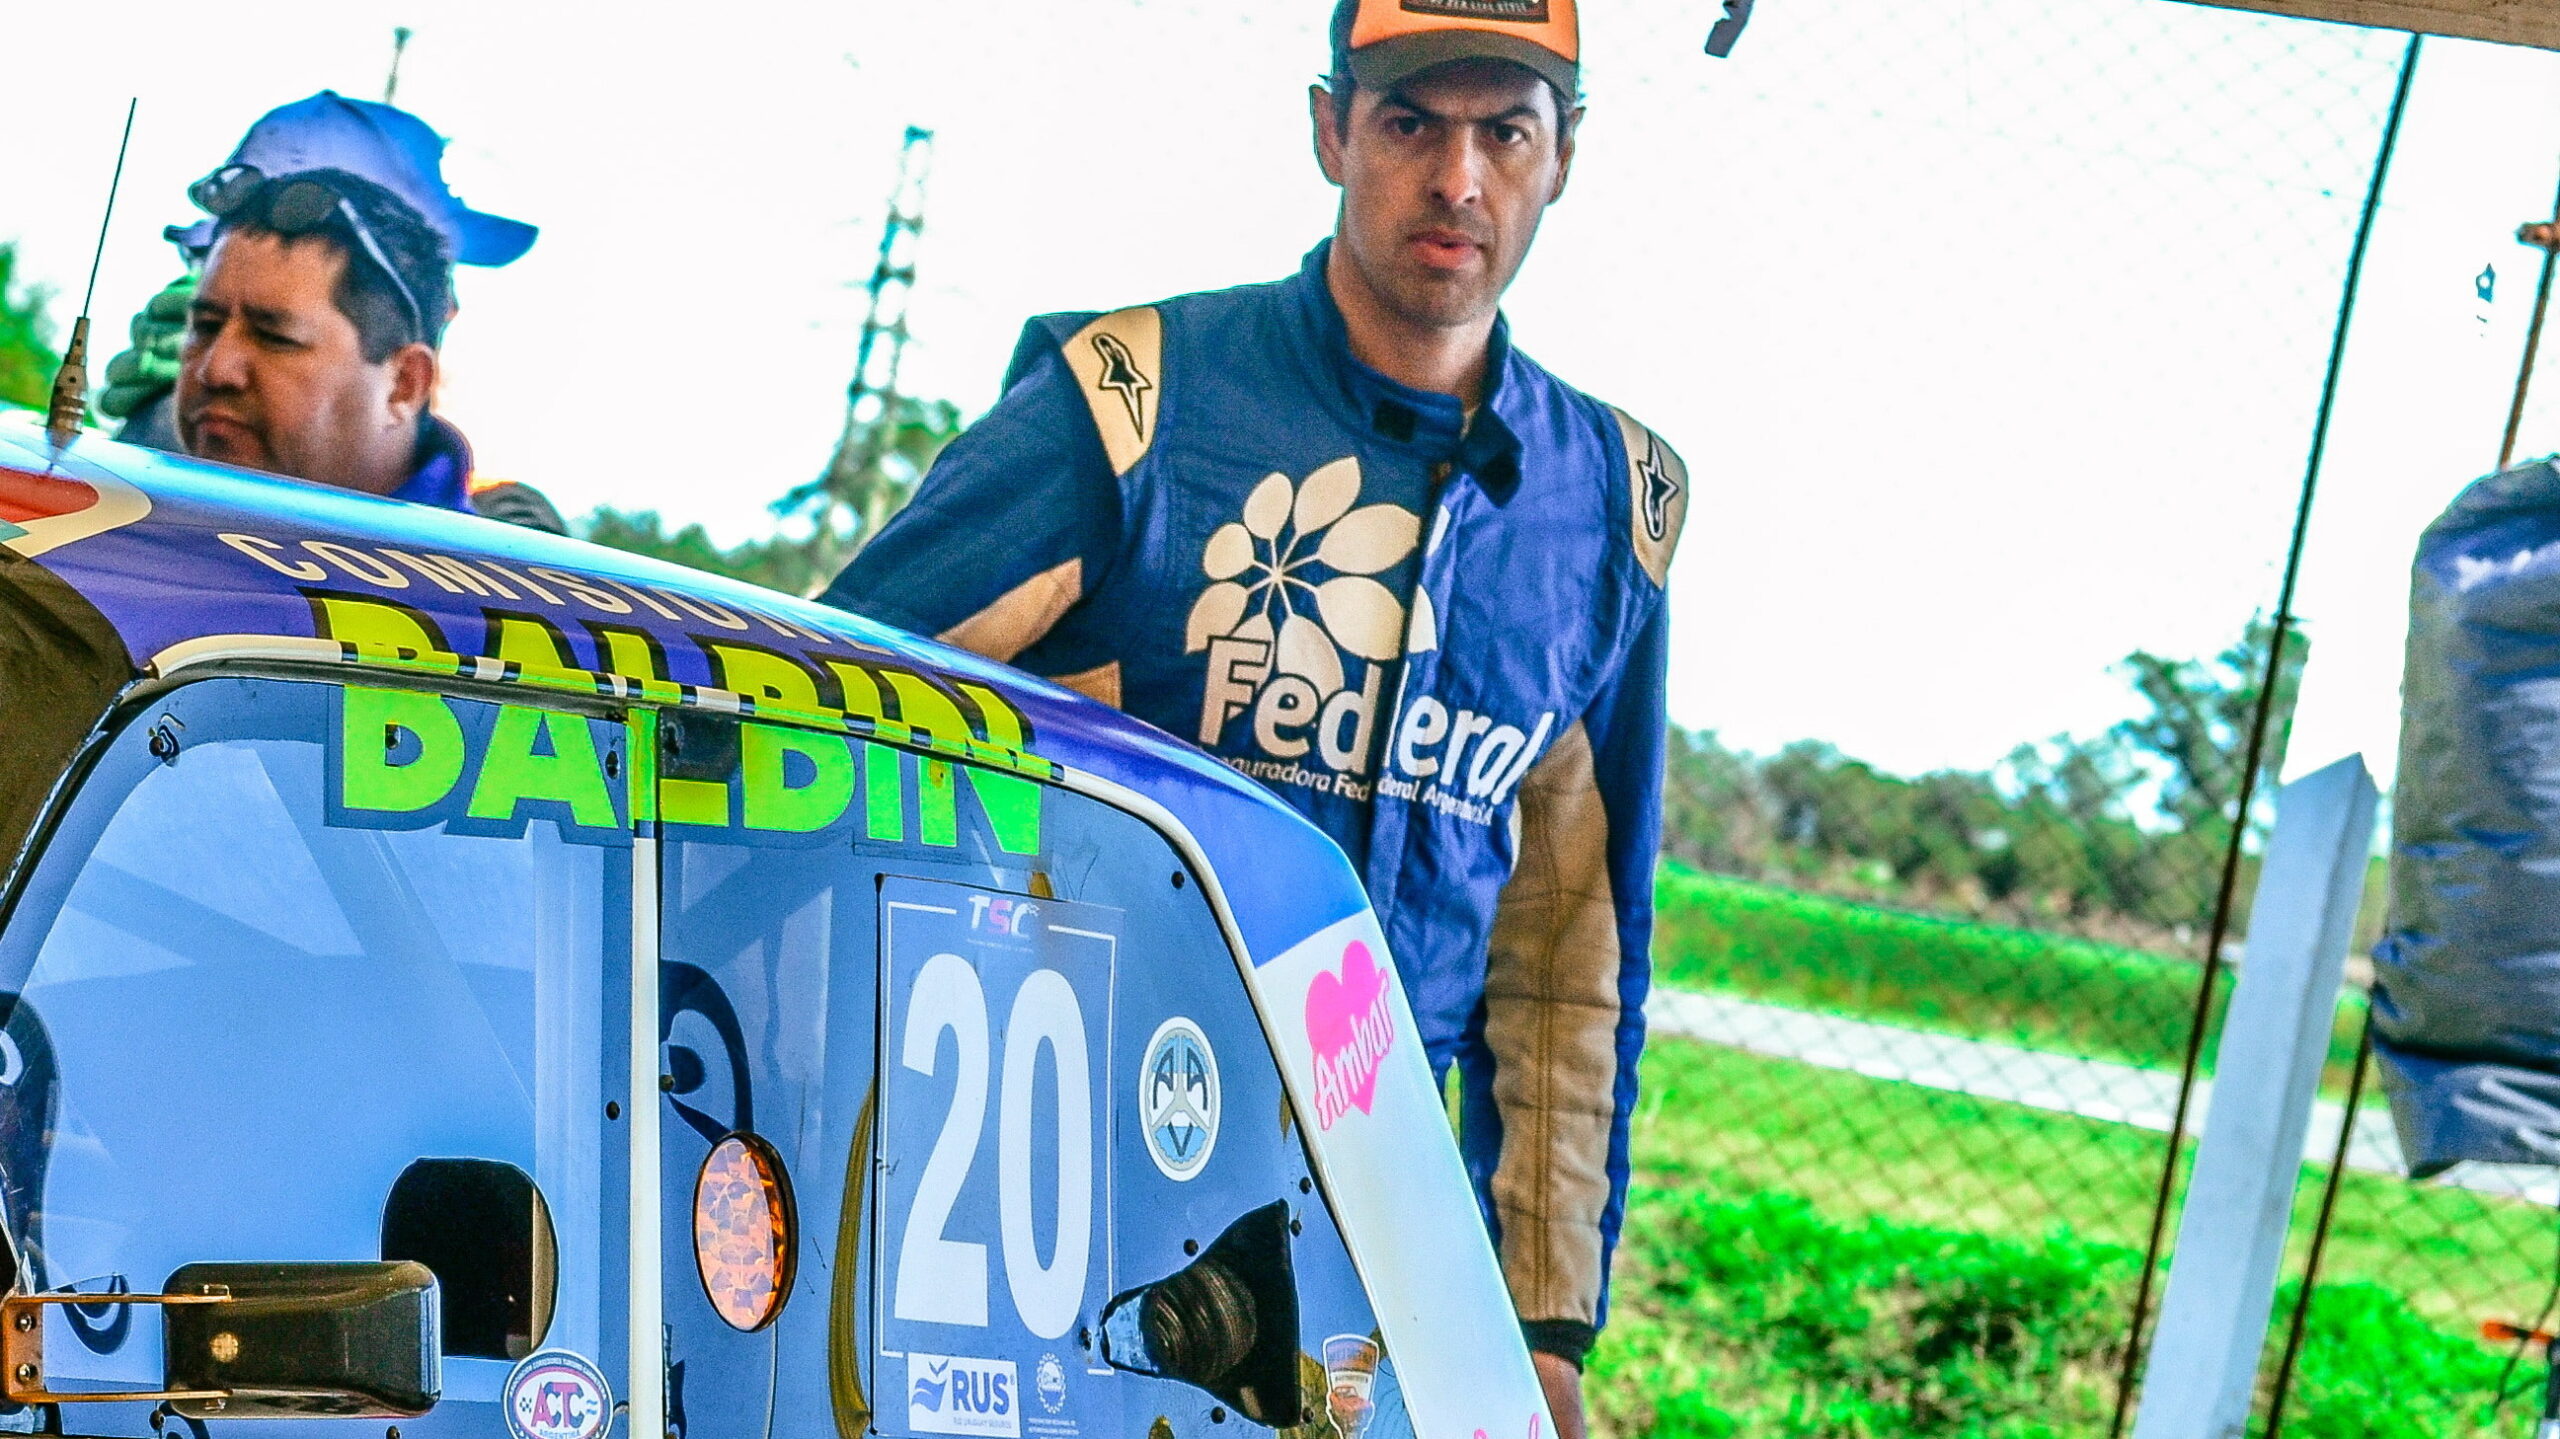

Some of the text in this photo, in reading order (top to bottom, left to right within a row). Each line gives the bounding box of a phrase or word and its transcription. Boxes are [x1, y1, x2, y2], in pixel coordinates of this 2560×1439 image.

[966, 892, 1041, 939] TSC
[1314, 967, 1394, 1131] Ambar
[894, 952, 1093, 1340] 20
[952, 1369, 1010, 1416] RUS
